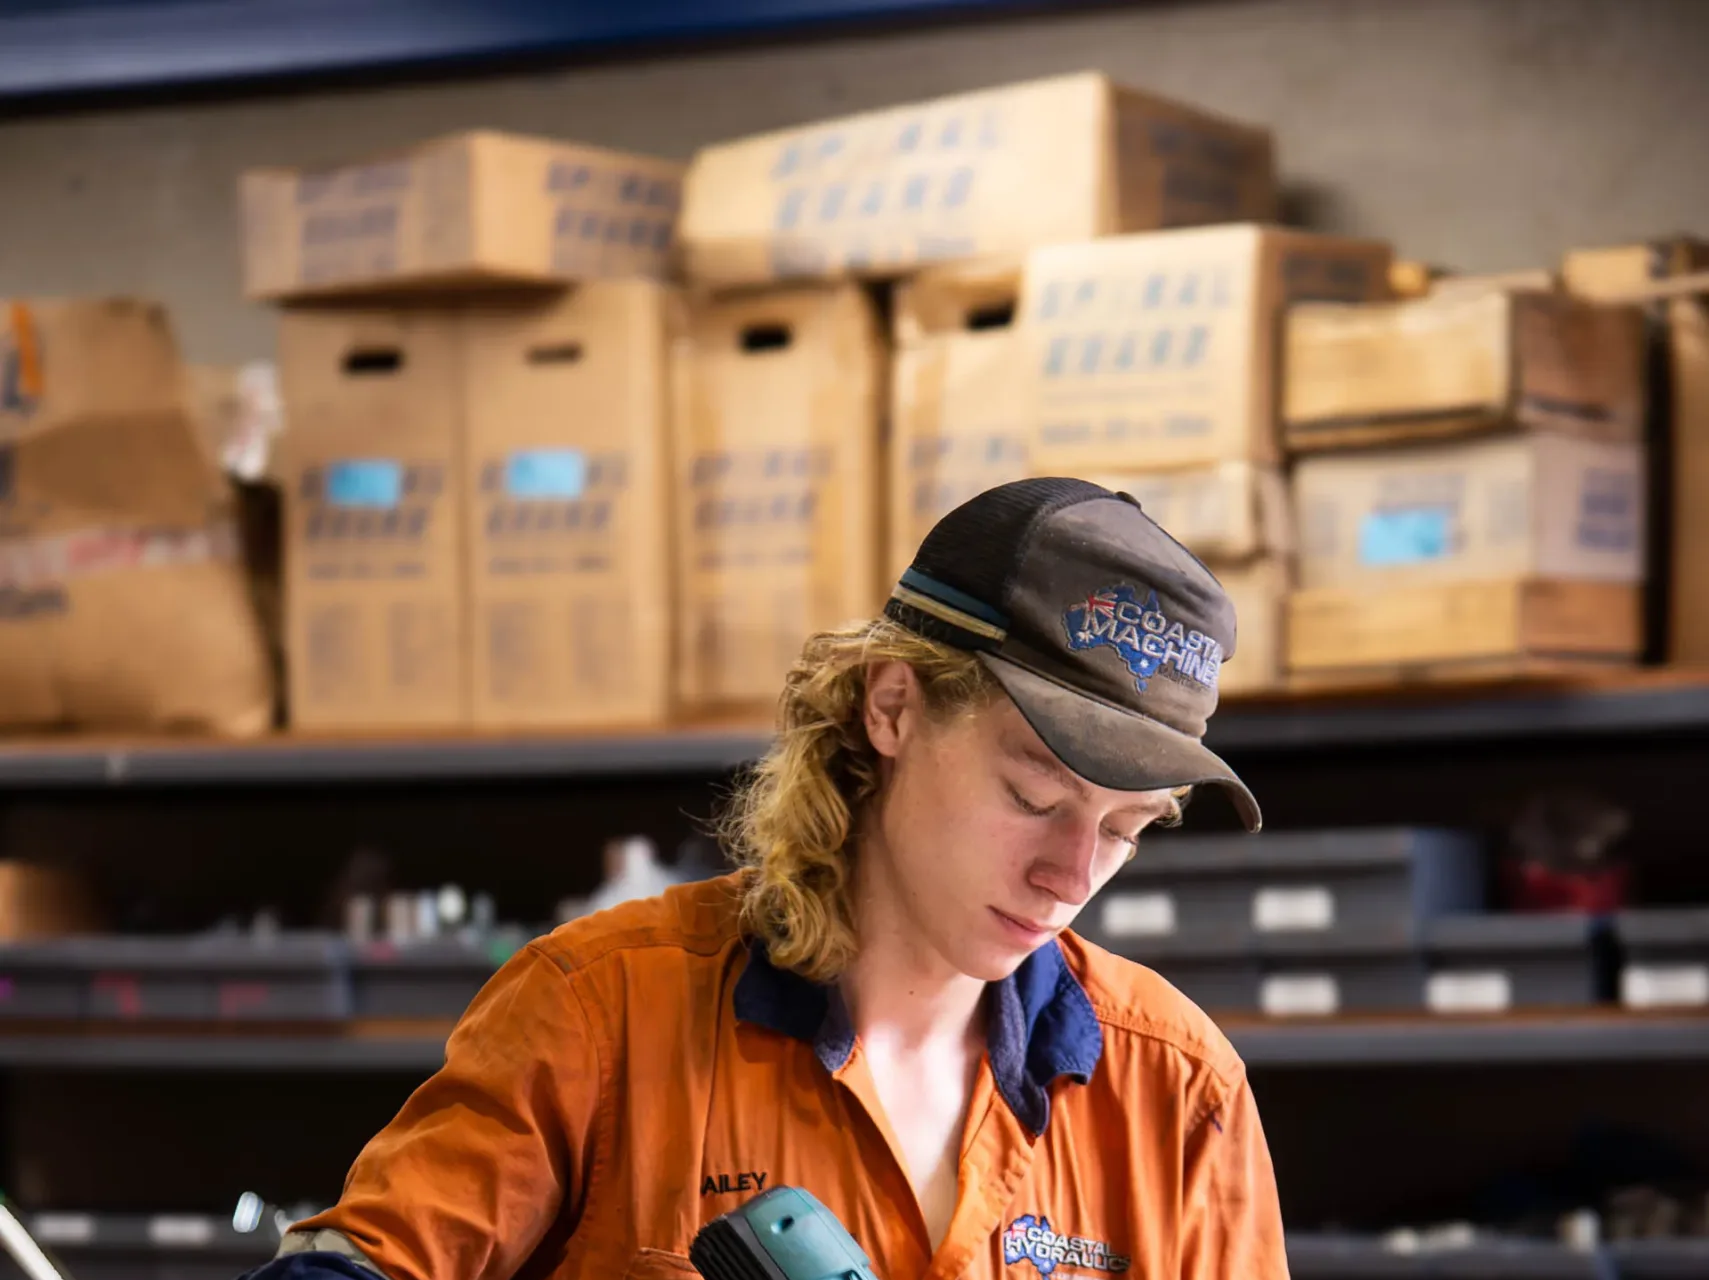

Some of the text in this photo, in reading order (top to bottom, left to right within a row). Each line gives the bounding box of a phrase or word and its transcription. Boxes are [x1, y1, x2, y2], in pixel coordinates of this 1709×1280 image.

[701, 1172, 767, 1195] AILEY
[1005, 1232, 1132, 1274] HYDRAULICS
[1026, 1227, 1116, 1257] COASTAL
